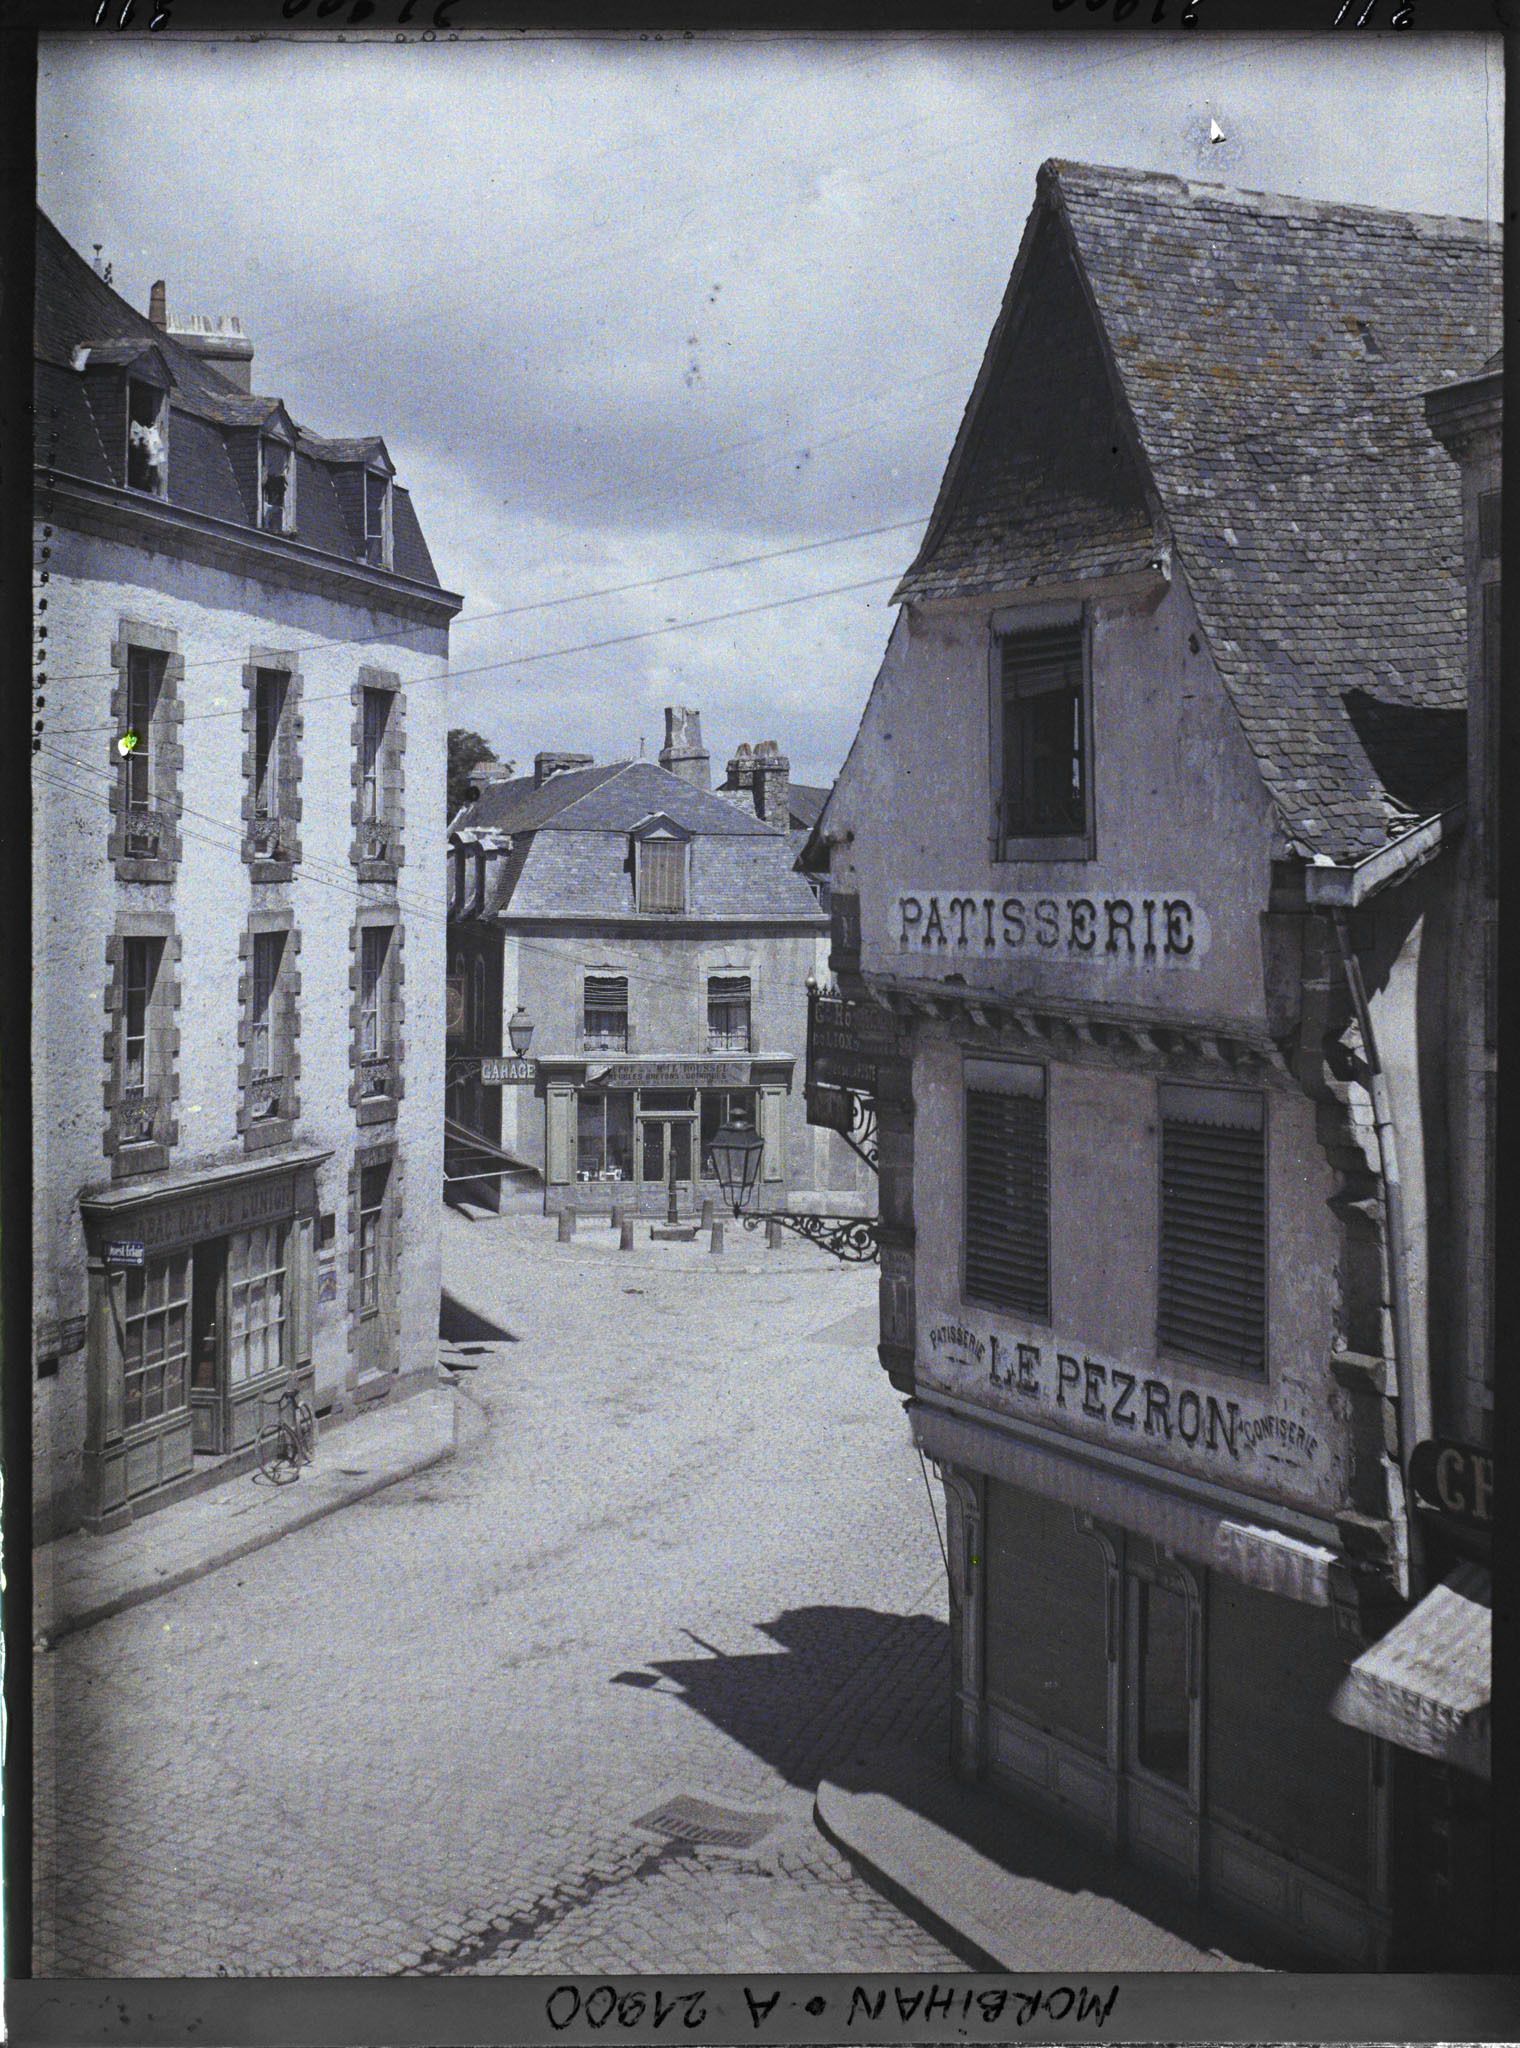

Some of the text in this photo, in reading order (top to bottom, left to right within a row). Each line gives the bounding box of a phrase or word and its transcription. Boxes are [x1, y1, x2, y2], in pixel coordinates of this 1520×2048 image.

[899, 897, 1195, 955] PATISSERIE
[481, 1063, 536, 1079] GARAGE
[929, 1325, 986, 1362] PATISSERIE
[989, 1334, 1240, 1459] LE PEZRON
[1244, 1415, 1318, 1460] CONFISERIE
